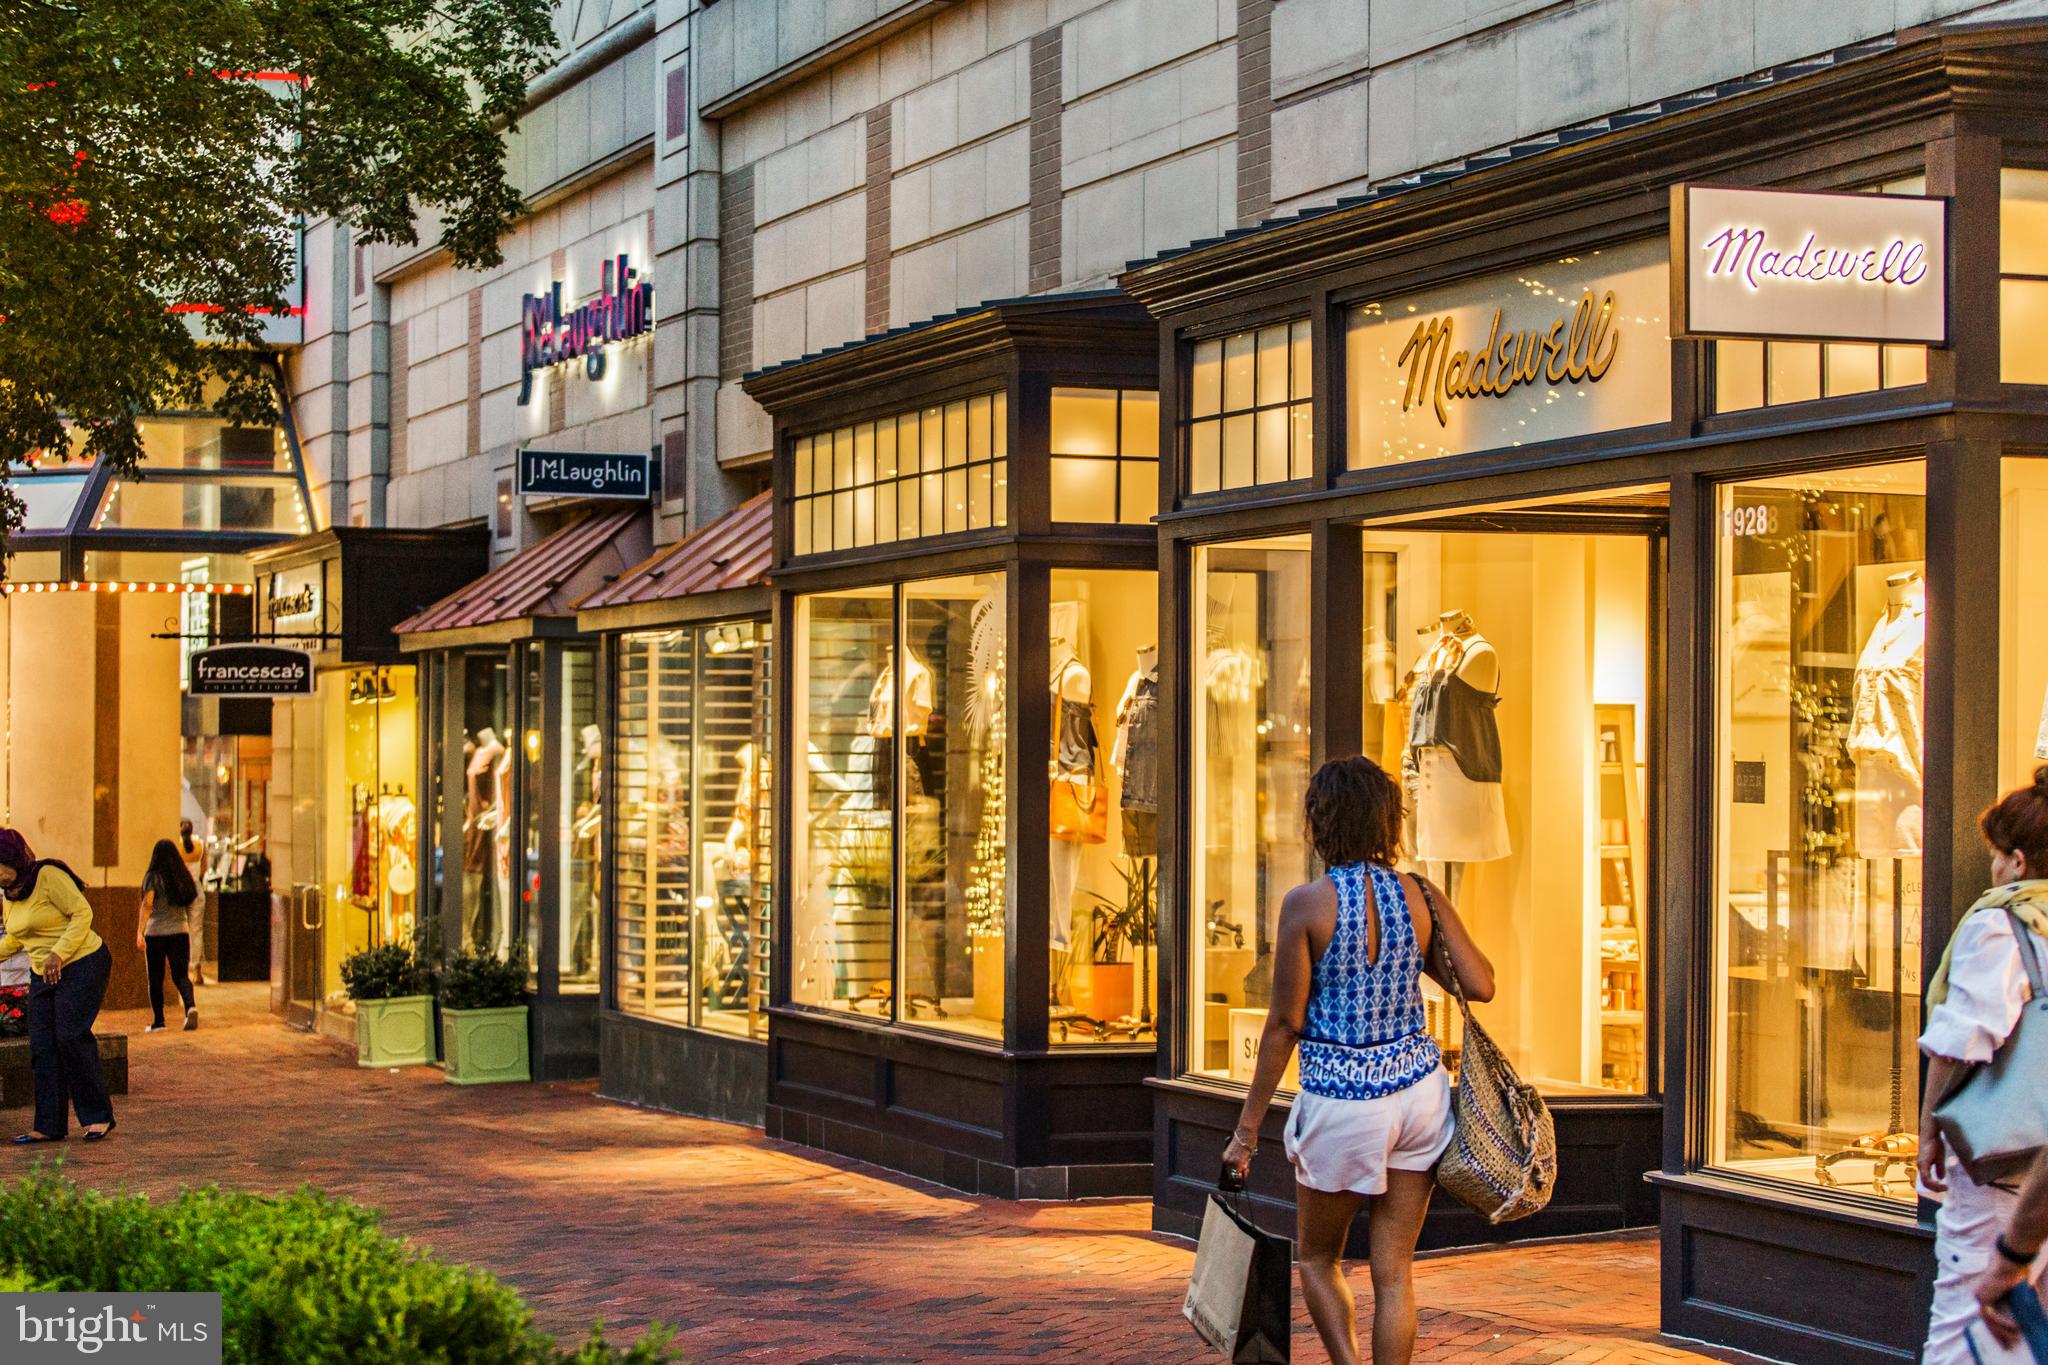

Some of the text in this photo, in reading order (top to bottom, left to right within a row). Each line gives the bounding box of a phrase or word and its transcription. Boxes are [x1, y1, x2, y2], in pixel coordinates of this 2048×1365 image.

[1707, 227, 1928, 289] Madewell
[1398, 290, 1619, 428] Madewell
[526, 457, 641, 488] J.McLaughlin
[198, 657, 305, 679] francesca's
[1736, 775, 1762, 787] OPEN
[1244, 1037, 1259, 1059] SA
